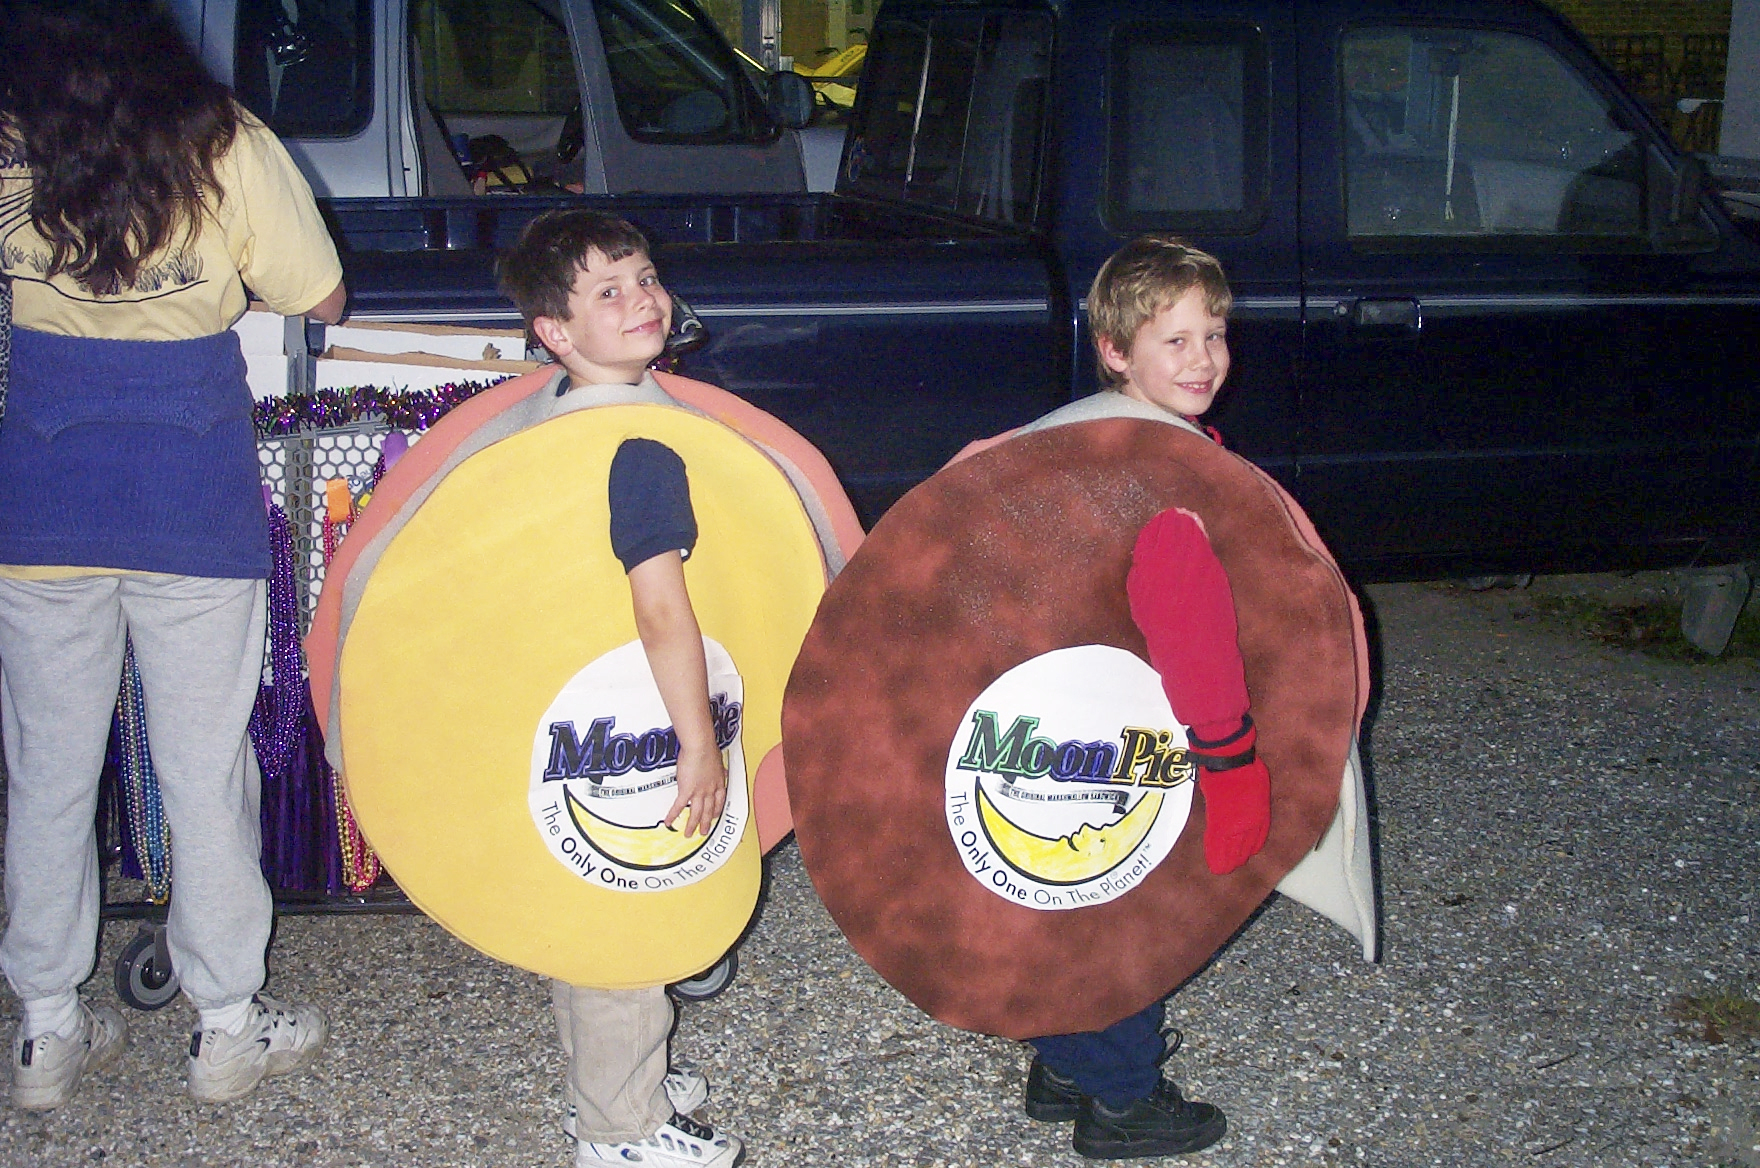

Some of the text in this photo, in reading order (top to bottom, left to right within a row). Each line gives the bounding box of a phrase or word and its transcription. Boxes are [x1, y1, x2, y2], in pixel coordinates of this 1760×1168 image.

[956, 709, 1192, 789] MoonPie
[541, 800, 561, 836] The
[561, 837, 597, 876] Only
[600, 867, 639, 890] One
[644, 876, 674, 890] On
[673, 863, 707, 881] The
[950, 791, 967, 826] The
[961, 830, 992, 874] Only
[992, 870, 1028, 900] One
[1034, 889, 1063, 906] On
[1066, 890, 1101, 906] The
